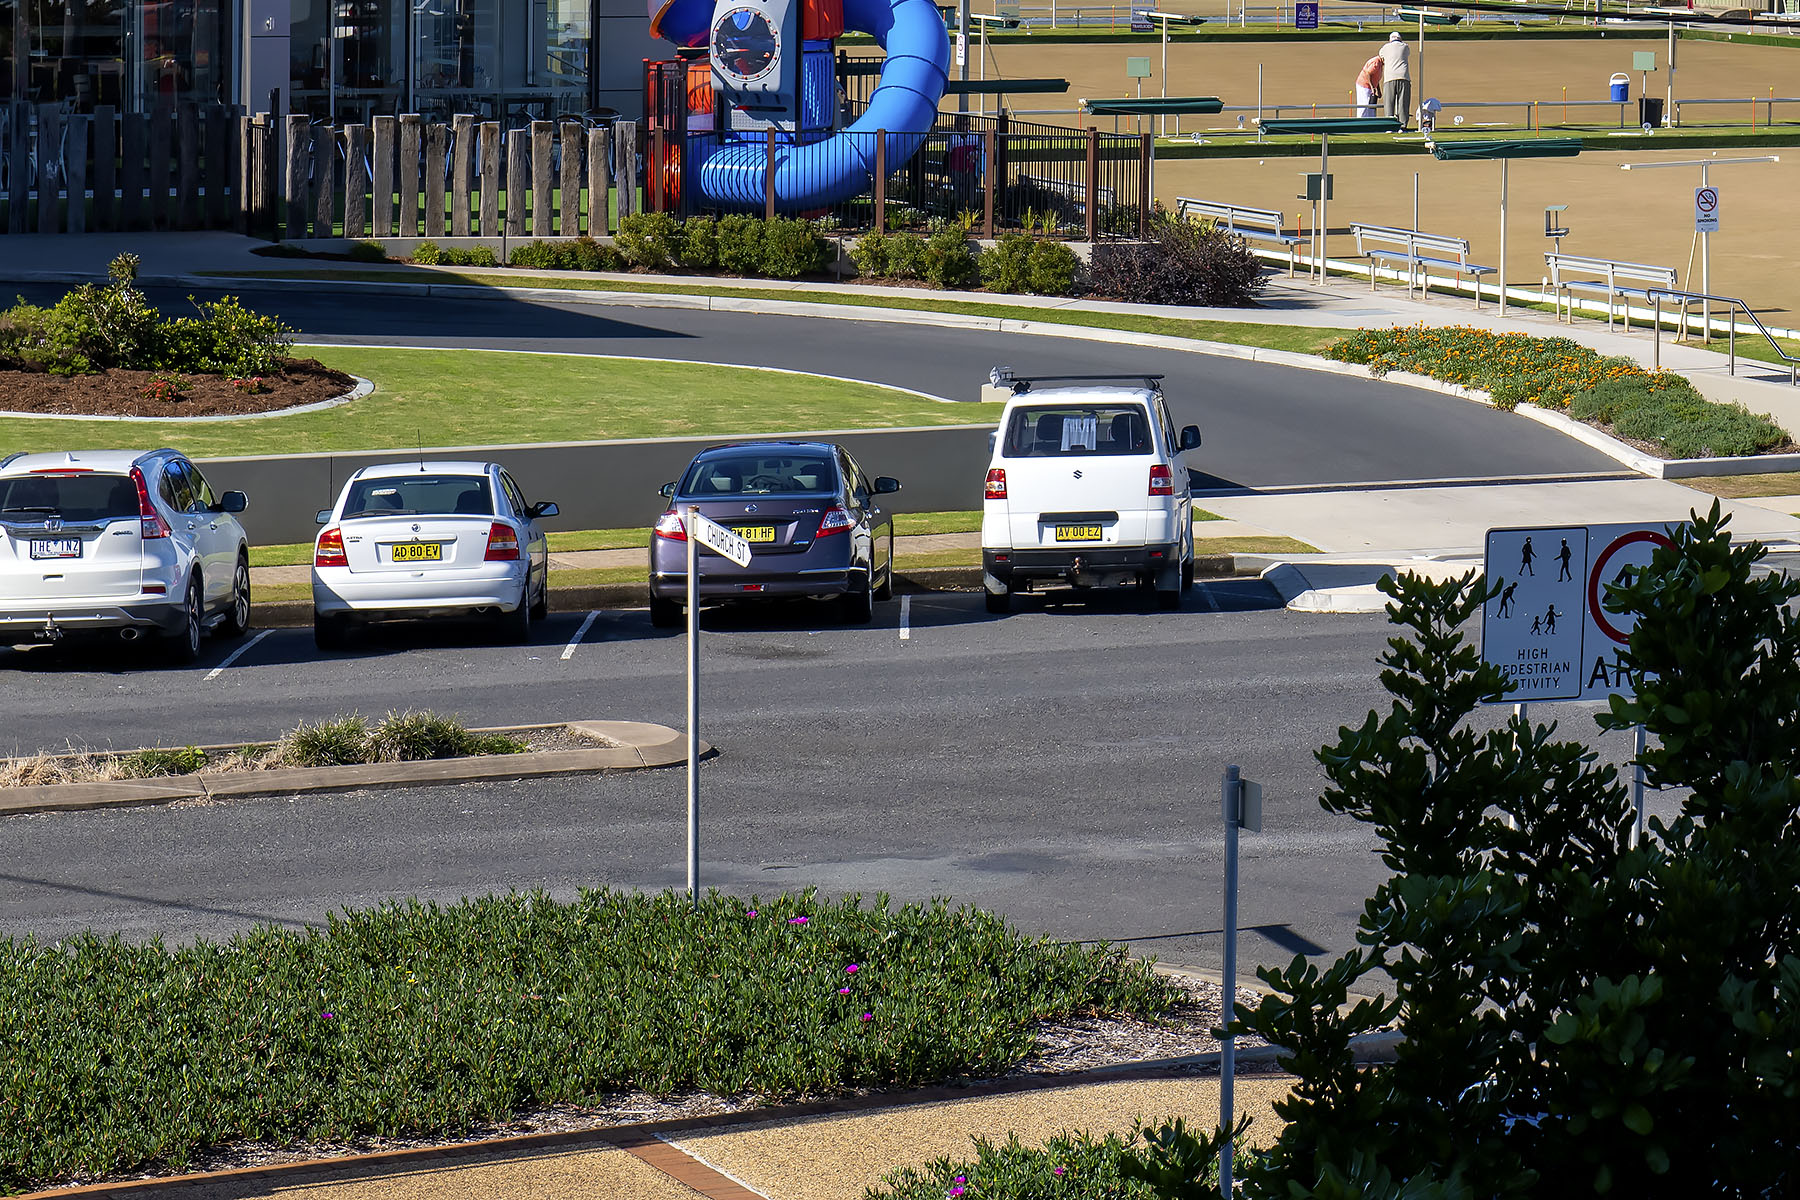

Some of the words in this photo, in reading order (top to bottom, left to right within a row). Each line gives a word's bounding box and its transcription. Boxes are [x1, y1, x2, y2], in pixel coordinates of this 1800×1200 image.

[707, 524, 734, 555] CHURCH
[736, 541, 746, 562] ST
[1517, 648, 1548, 660] HIGH
[1502, 661, 1570, 675] EDESTRIAN
[1513, 677, 1560, 689] TIVITY
